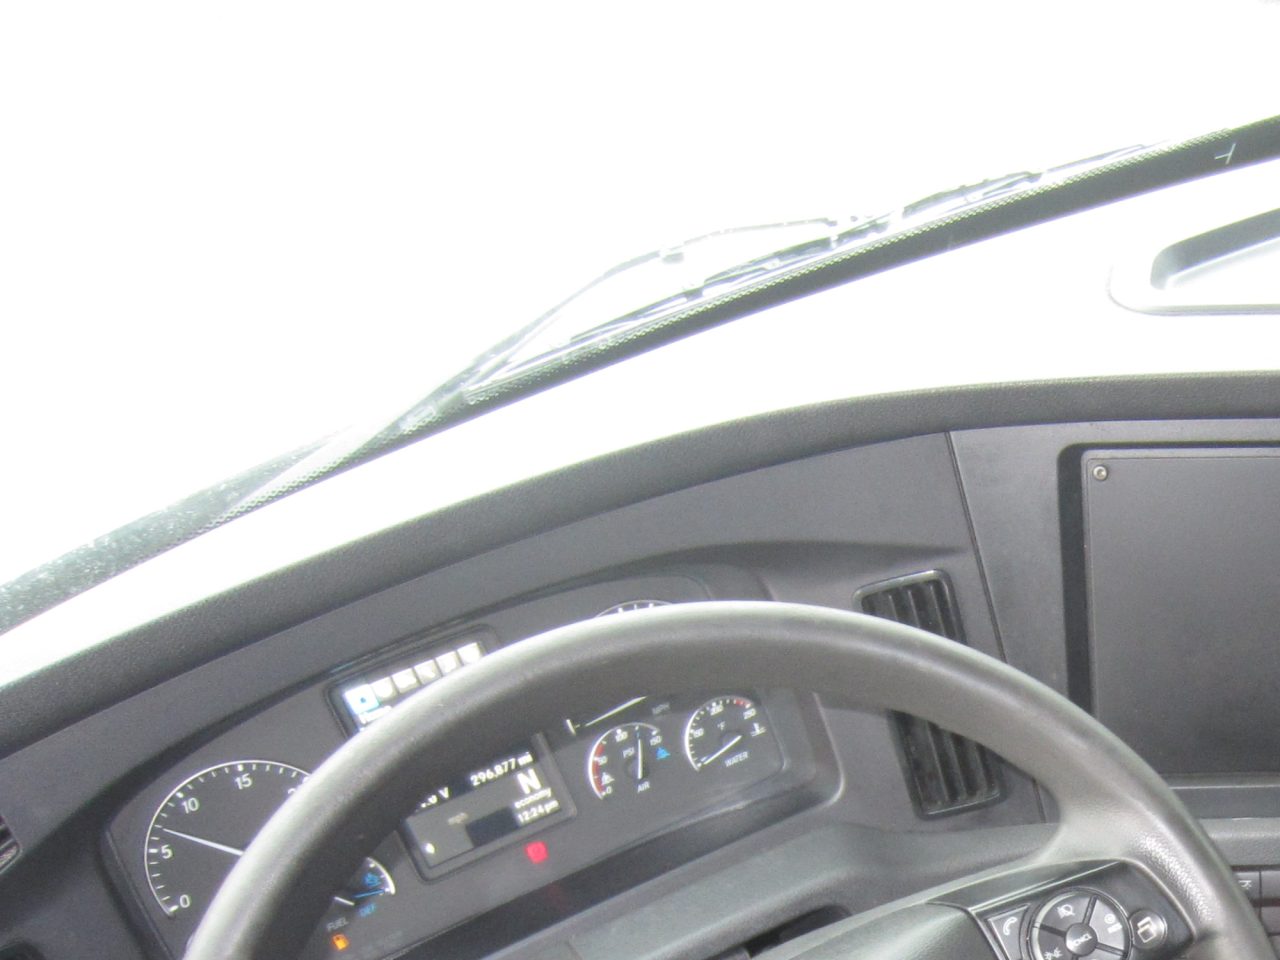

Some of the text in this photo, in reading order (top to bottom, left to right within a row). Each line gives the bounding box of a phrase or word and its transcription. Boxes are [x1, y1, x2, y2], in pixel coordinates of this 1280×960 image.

[724, 751, 749, 768] WATER
[235, 773, 253, 790] 15
[517, 768, 541, 794] N
[637, 781, 650, 793] AIR
[181, 797, 199, 814] 10
[160, 844, 173, 860] 5
[179, 894, 191, 908] 0
